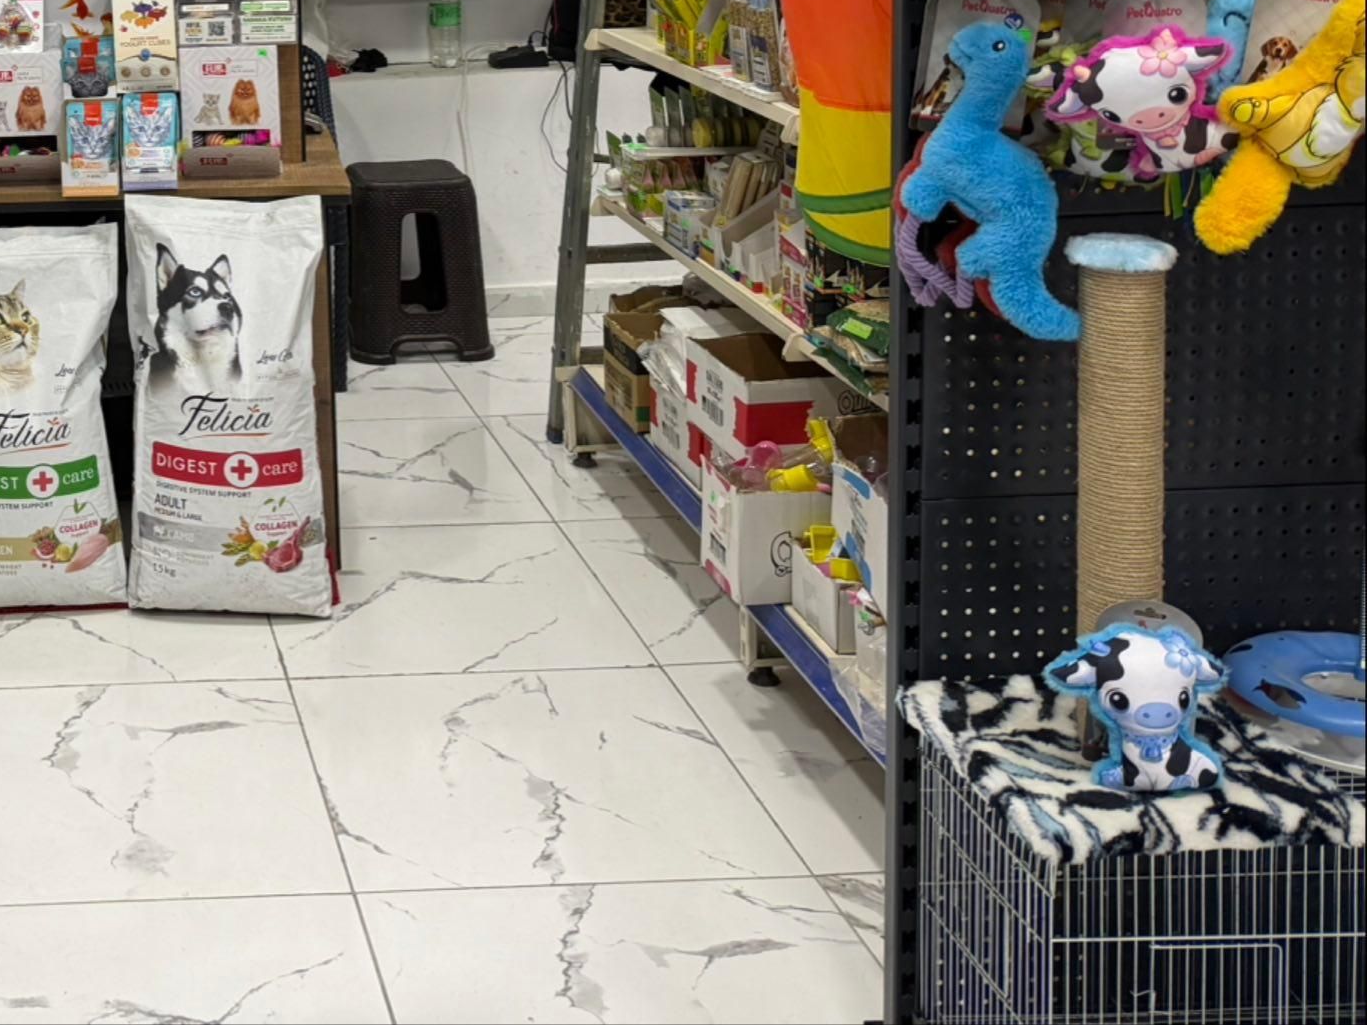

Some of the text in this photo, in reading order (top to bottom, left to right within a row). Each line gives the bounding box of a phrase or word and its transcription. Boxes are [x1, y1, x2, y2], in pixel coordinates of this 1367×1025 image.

[1126, 0, 1183, 20] PetQuatro
[179, 392, 273, 439] Felicia
[156, 452, 299, 477] DIGEST care
[62, 465, 94, 485] care
[155, 480, 252, 499] DIGESTIVE SYSTEM SUPPORT
[21, 501, 54, 510] SUPPORT
[154, 493, 188, 510] ADULT
[59, 518, 99, 534] COLLAGEN
[254, 521, 299, 532] COLLAGEN
